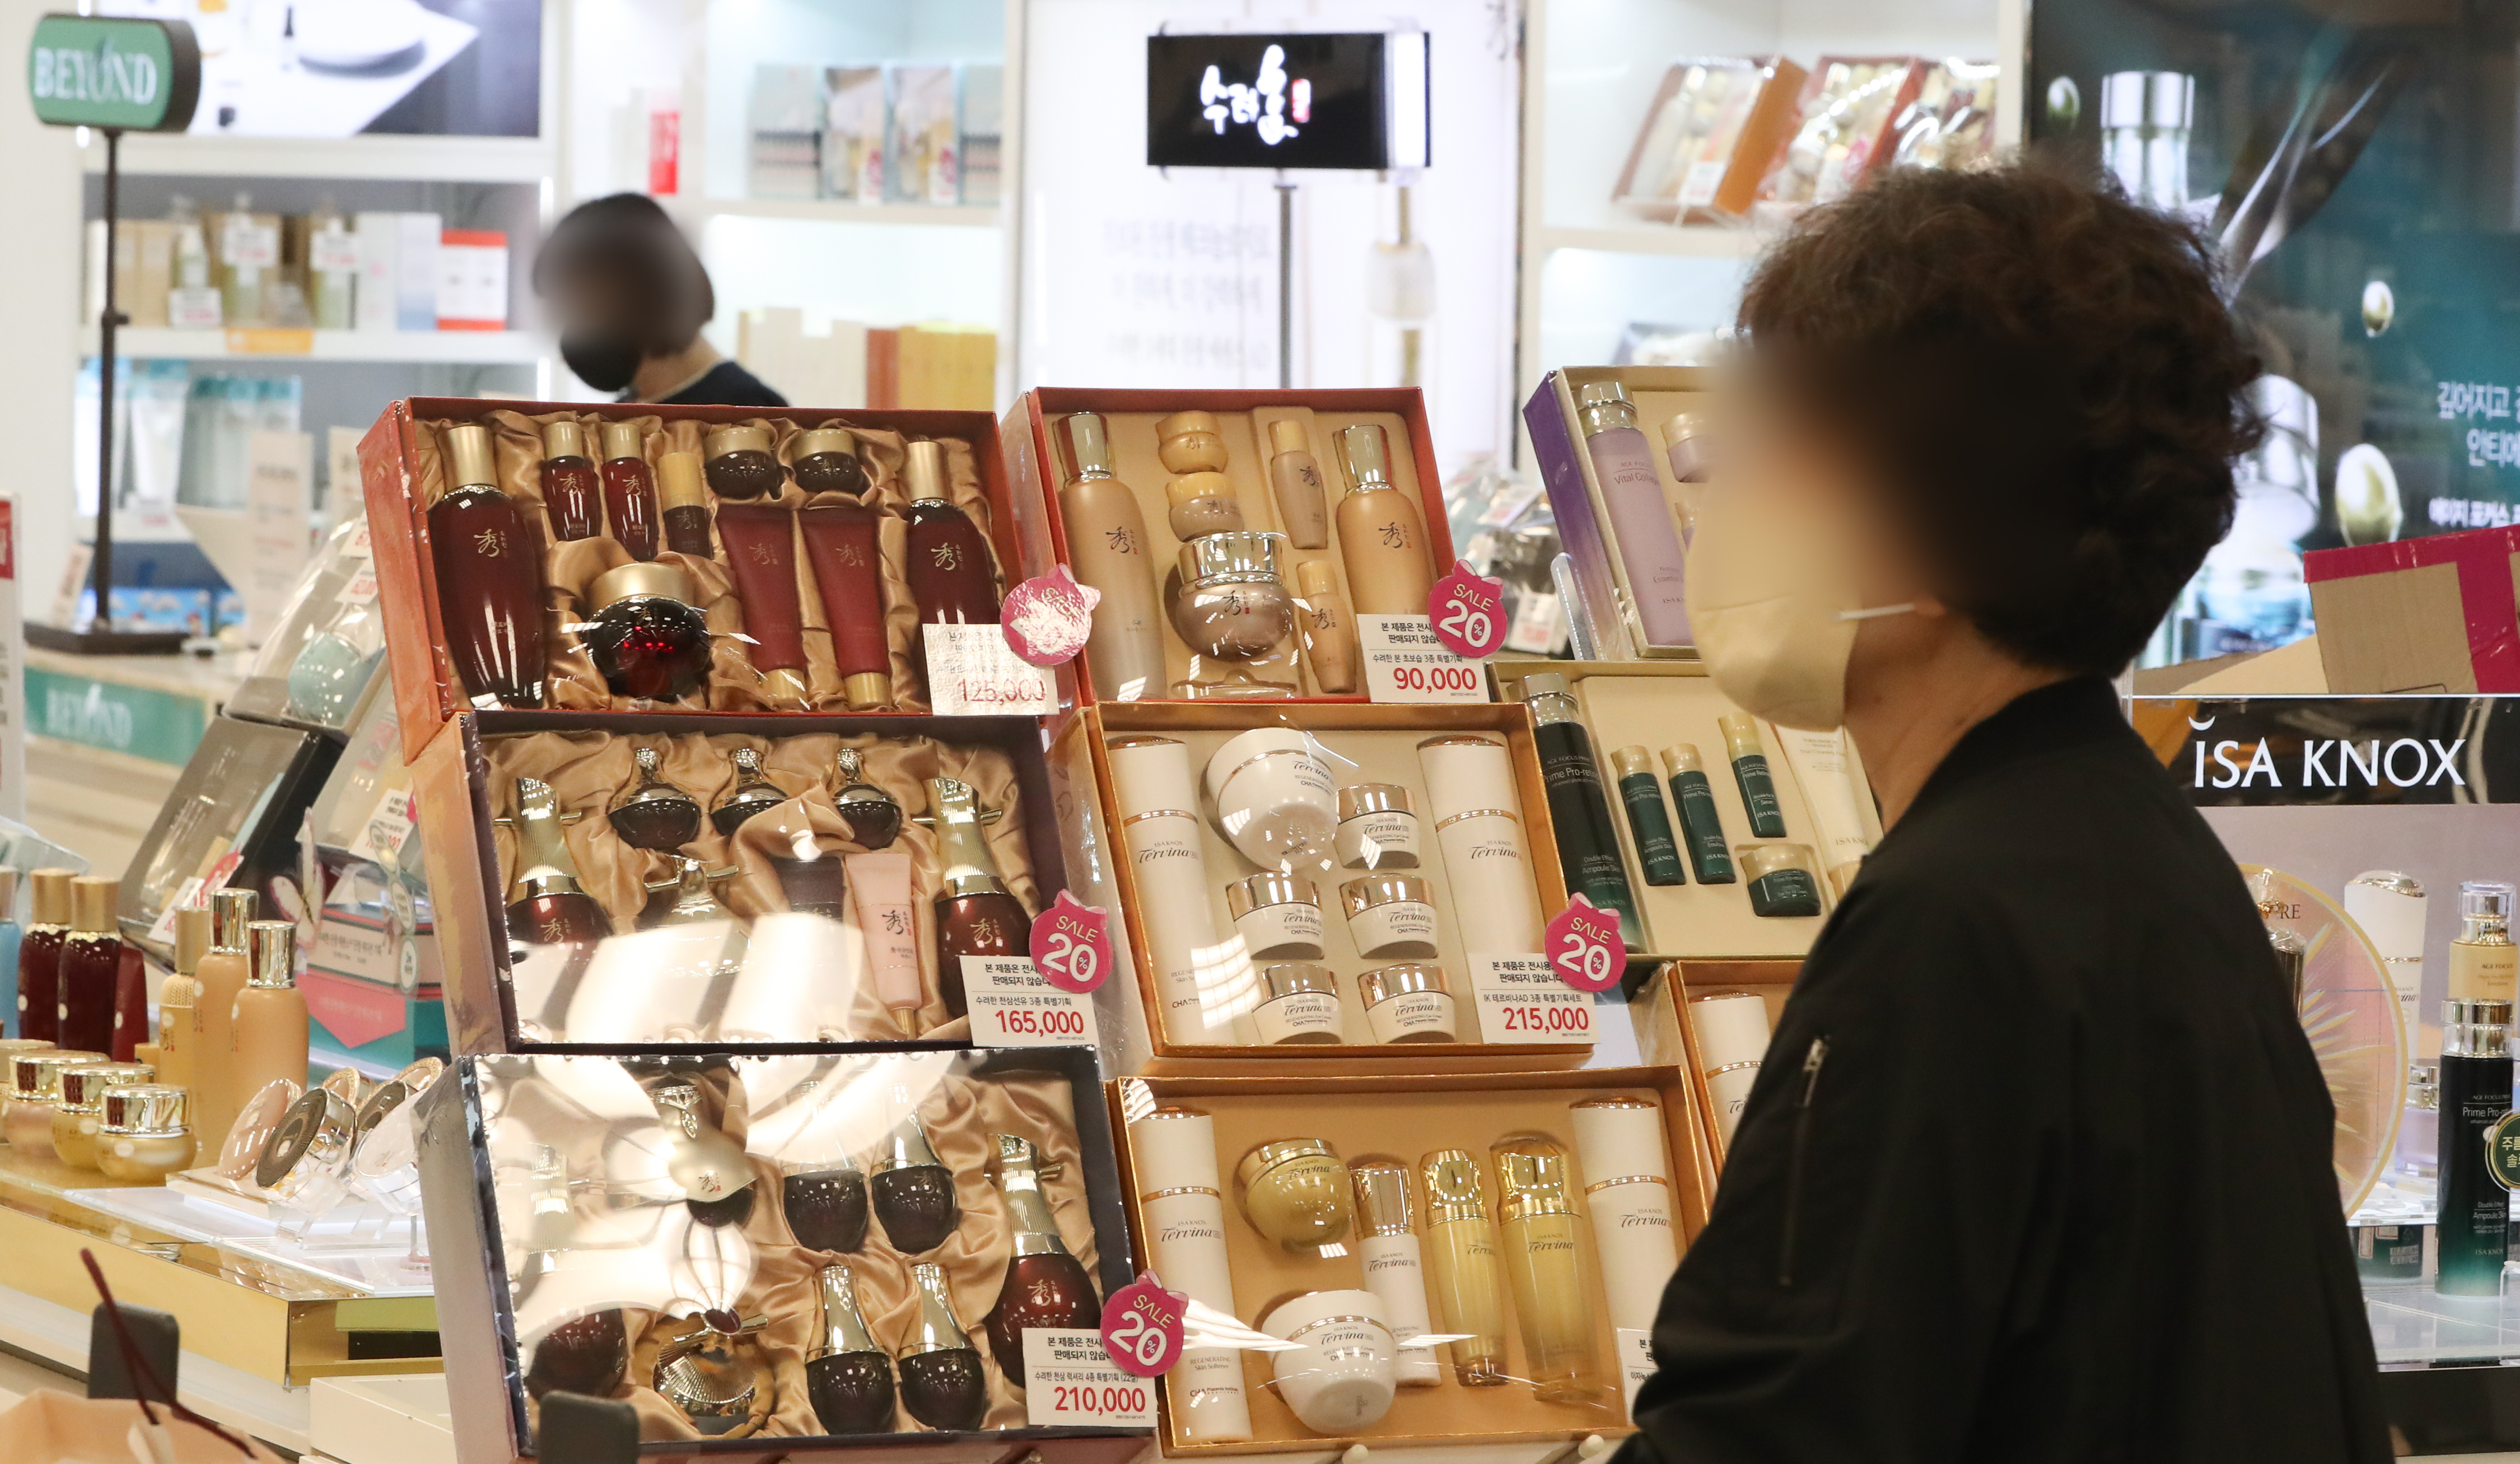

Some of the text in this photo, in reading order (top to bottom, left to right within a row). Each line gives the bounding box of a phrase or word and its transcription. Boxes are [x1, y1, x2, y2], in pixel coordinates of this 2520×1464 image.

[2437, 380, 2510, 421] 깊어지고
[1615, 475, 1634, 484] Vital
[1106, 526, 1130, 554] 秀
[1379, 521, 1403, 549] 秀
[474, 529, 500, 557] 秀
[931, 542, 955, 571] 秀
[1454, 584, 1494, 612] SALE
[1382, 622, 1434, 632] 본 제품은 전시
[1388, 634, 1419, 644] 판매되지
[1373, 654, 1392, 663] 수려한
[1403, 655, 1422, 663] 초보습
[1424, 655, 1434, 663] 3종
[1393, 667, 1477, 693] 90,000
[958, 678, 1047, 705] 125,000
[2303, 737, 2467, 788] KNOX
[882, 910, 903, 934] 秀
[1056, 916, 1099, 943] SALE
[1571, 917, 1612, 944] SALE
[985, 963, 1041, 973] 본 제품은 전시
[1492, 961, 1553, 971] 본 제품은 전시용
[1171, 969, 1194, 978] REGENE
[1500, 973, 1529, 983] 판매되지
[992, 976, 1024, 986] 판매되지
[976, 996, 1072, 1006] 수려한 천삼선유 3종 특별기획
[1492, 994, 1528, 1003] 테르비나AD
[1530, 994, 1541, 1003] 3종
[1543, 994, 1583, 1003] 특별기획세트
[996, 1010, 1084, 1037] 165,000
[1502, 1007, 1589, 1034] 215,000
[1727, 1100, 1744, 1114] Te
[2462, 1107, 2485, 1117] Prime
[2506, 1153, 2520, 1168] 솔
[2473, 1211, 2498, 1220] Ampoule
[1133, 1294, 1175, 1329] SALE
[1048, 1337, 1056, 1346] 본
[1058, 1337, 1083, 1347] 제품은
[1054, 1350, 1087, 1360] 판매되지
[1189, 1356, 1231, 1365] REGENERATING
[1035, 1372, 1052, 1381] 수려한
[1085, 1373, 1095, 1382] 4종
[1096, 1373, 1119, 1382] 특별기획
[1054, 1386, 1146, 1416] 210,000
